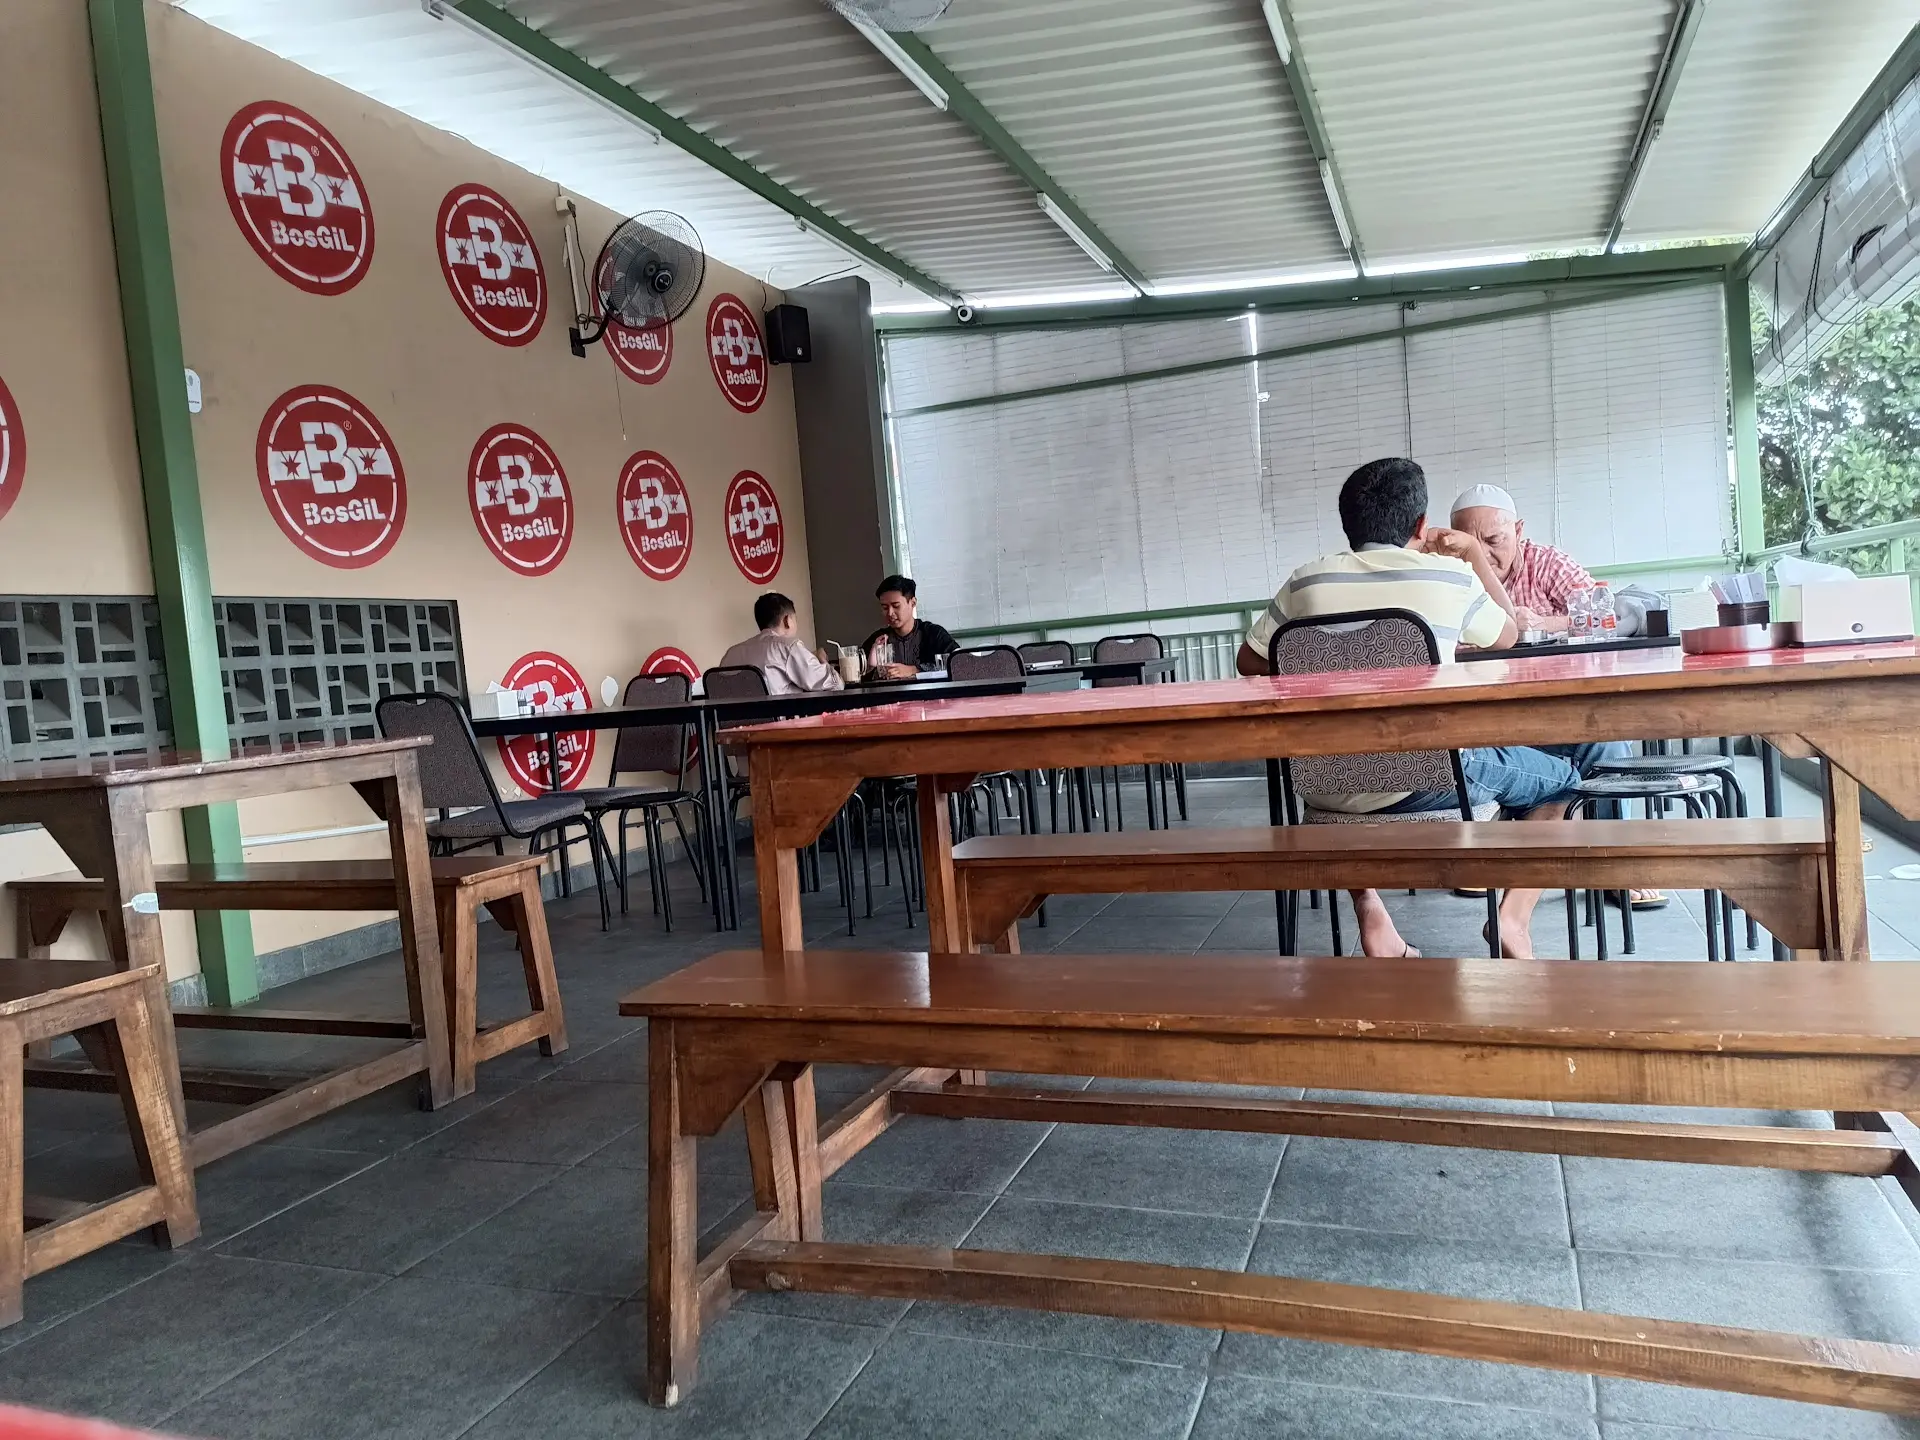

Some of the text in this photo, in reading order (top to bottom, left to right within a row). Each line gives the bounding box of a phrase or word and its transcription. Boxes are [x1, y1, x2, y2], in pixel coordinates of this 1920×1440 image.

[266, 138, 326, 218] B
[465, 215, 512, 281] B
[722, 317, 749, 366] B
[299, 421, 358, 494] B
[497, 455, 540, 516] B
[639, 477, 669, 530] B
[740, 492, 764, 540] B
[527, 733, 582, 772] BoGiL
